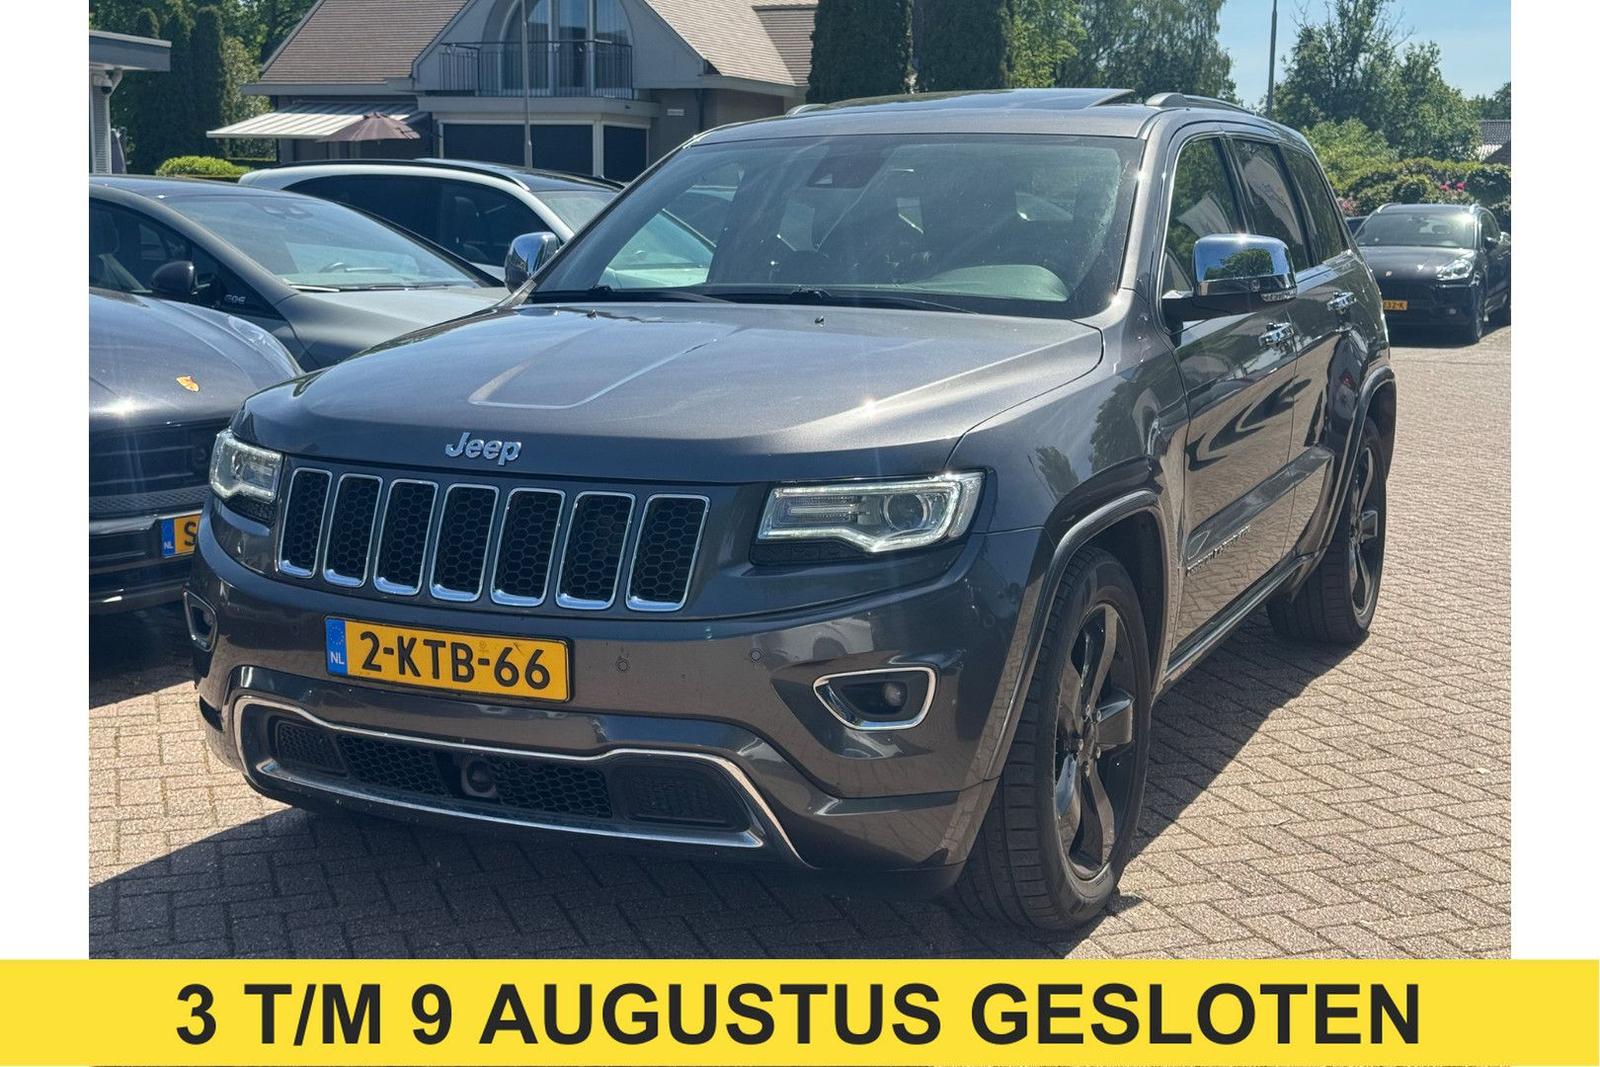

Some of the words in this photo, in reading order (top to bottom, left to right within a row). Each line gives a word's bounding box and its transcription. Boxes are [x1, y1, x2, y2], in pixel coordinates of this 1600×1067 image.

[445, 432, 521, 466] Jeep
[163, 541, 173, 550] NL
[330, 652, 345, 665] NL
[360, 631, 550, 690] 2-KTB-66
